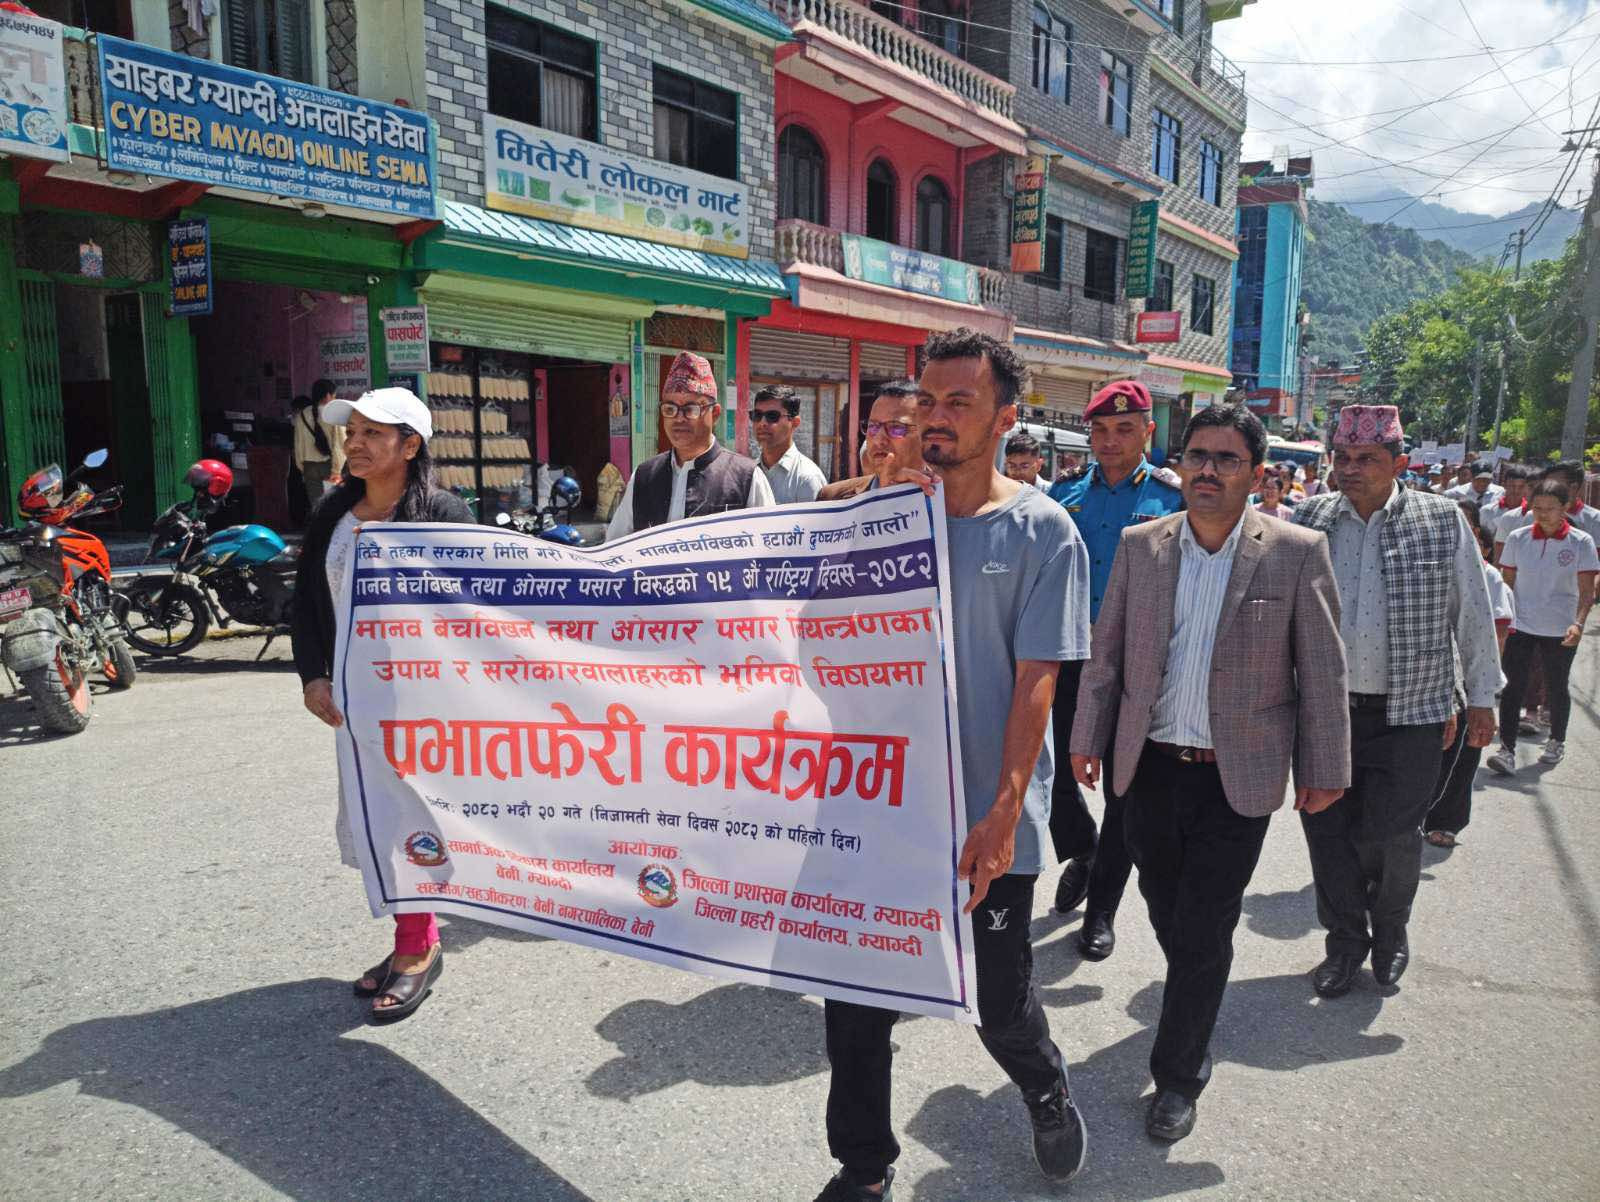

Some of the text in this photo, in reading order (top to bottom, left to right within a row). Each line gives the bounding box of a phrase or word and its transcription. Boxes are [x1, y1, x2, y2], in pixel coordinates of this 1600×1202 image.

[104, 54, 195, 104] साइबर
[198, 80, 277, 125] म्याग्दी
[284, 96, 382, 146] अनलाईन
[383, 110, 426, 153] सेवा
[110, 101, 429, 187] CYBER MYAGDI ONLINE SEWA
[495, 128, 741, 217] मितेरी लोकल मार्ट
[432, 546, 487, 562] सरकार
[356, 576, 392, 596] ानव
[470, 577, 507, 597] तथा
[513, 572, 572, 598] ओसार
[578, 577, 627, 600] पसार
[355, 618, 424, 641] मानव
[545, 619, 599, 643] तथा
[611, 613, 704, 645] ओसार
[715, 616, 781, 643] पसार
[371, 659, 442, 683] उपाय
[452, 659, 471, 683] र
[811, 655, 927, 690] विषयमा
[664, 708, 911, 808] कार्यक्रम
[462, 803, 499, 819] २०८२
[538, 804, 554, 819] २०
[562, 804, 582, 820] गते
[656, 809, 681, 828] सेवा
[687, 811, 720, 833] दिवस
[725, 819, 758, 841] २०८२
[764, 822, 783, 841] को
[788, 824, 826, 848] पहिलो
[552, 858, 616, 879] कार्यालय
[682, 868, 730, 896] जिल्ला
[873, 905, 943, 932] म्याग्दी
[694, 896, 738, 924] जिल्ला
[857, 932, 924, 957] म्याग्दी
